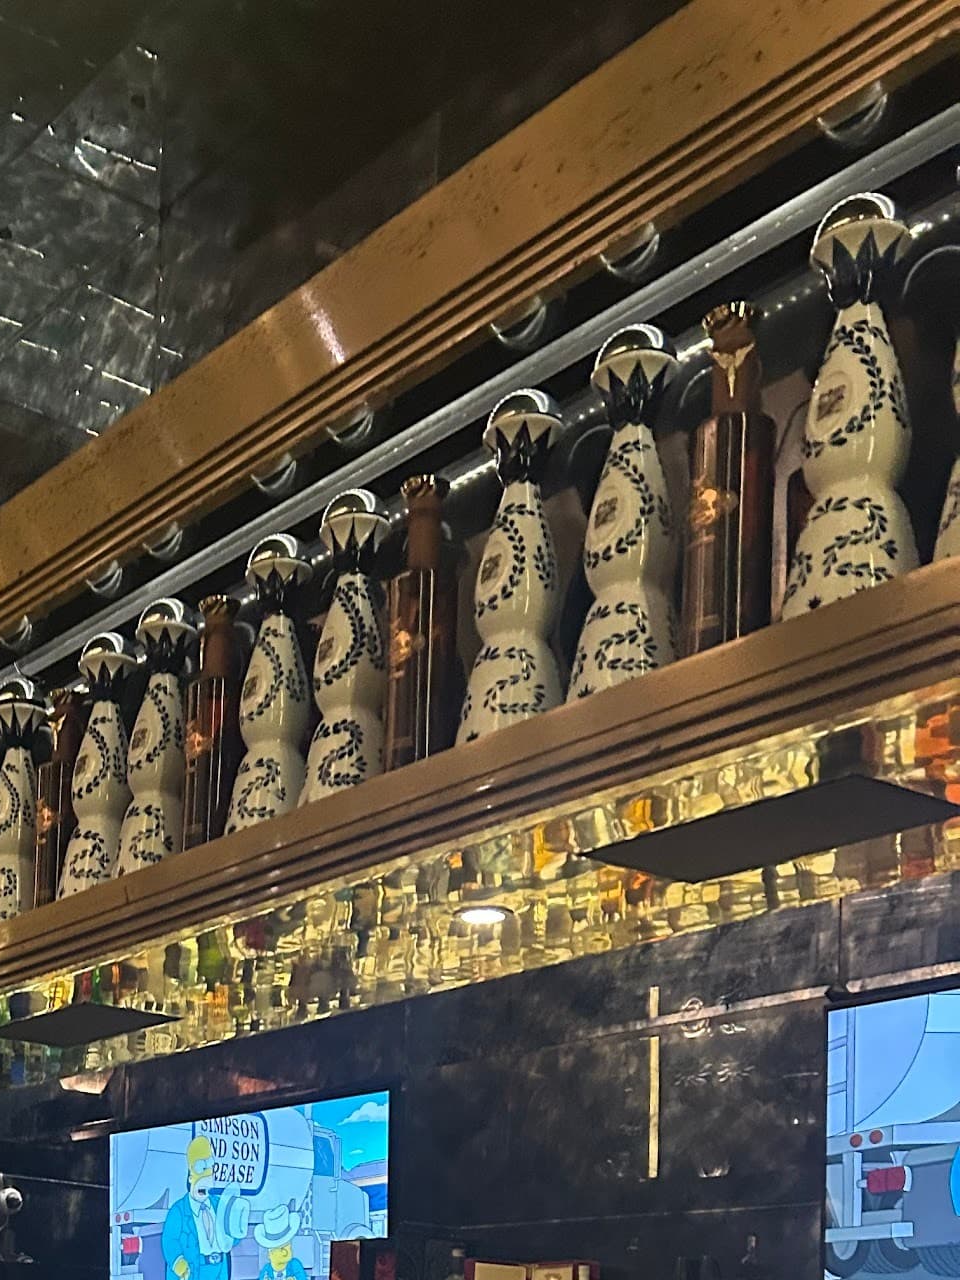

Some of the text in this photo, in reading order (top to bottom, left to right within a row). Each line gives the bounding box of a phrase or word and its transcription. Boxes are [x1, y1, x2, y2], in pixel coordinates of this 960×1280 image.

[201, 1116, 259, 1140] SIMPSON
[210, 1137, 259, 1162] ND SON
[212, 1162, 255, 1184] REASE
